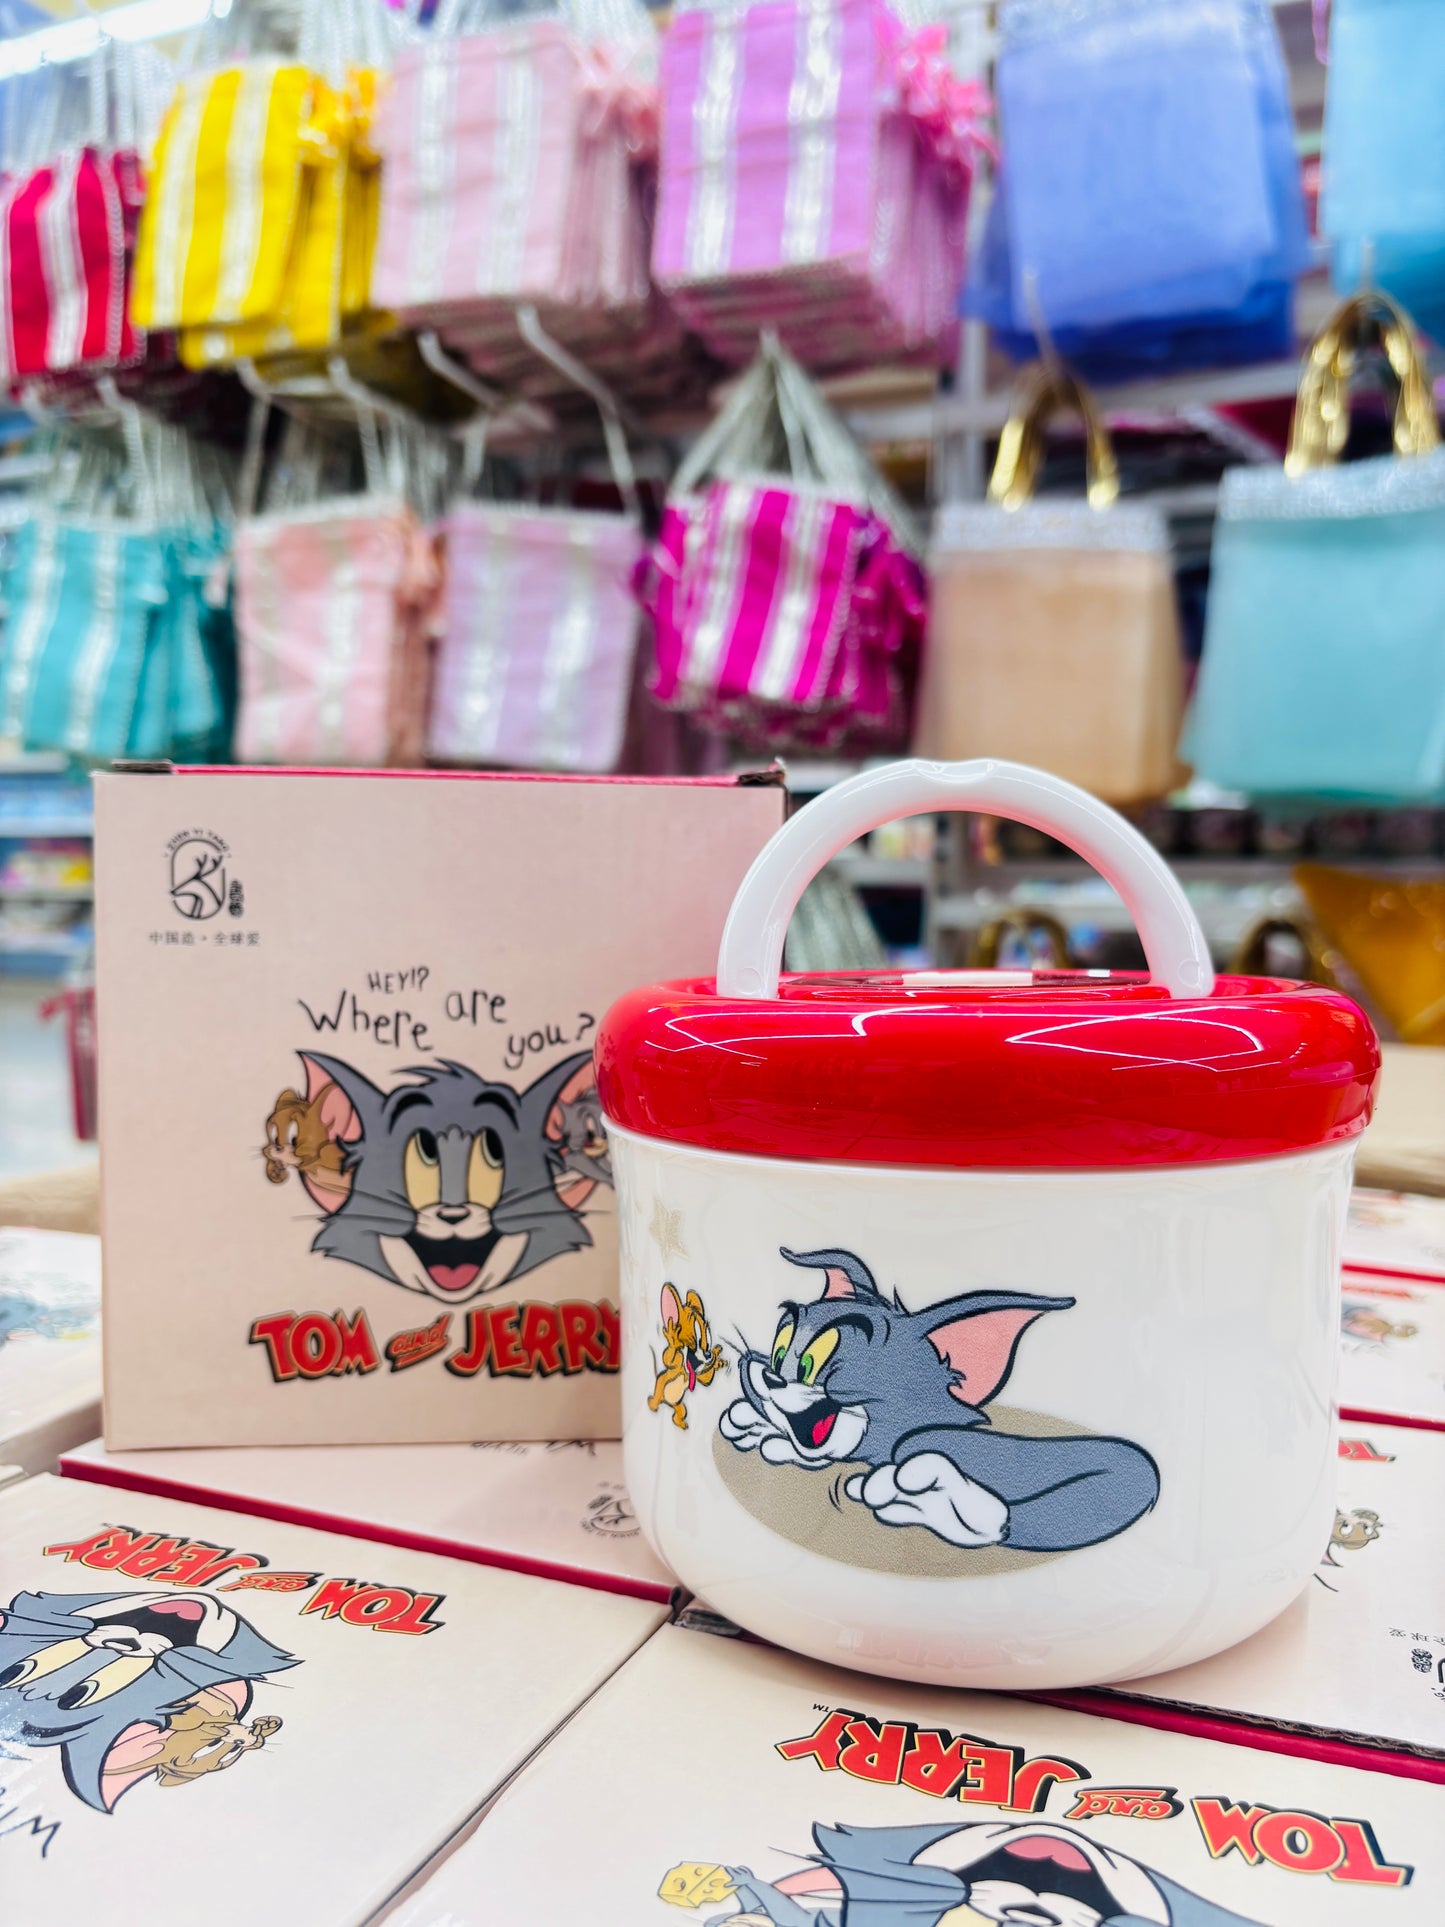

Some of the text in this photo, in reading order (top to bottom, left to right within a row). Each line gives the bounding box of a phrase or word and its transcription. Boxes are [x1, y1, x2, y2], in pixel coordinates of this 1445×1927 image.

[367, 966, 430, 993] HEY!?
[298, 989, 596, 1070] Where are you?
[249, 1307, 382, 1382] TOM
[385, 1311, 453, 1372] and
[43, 1525, 448, 1636] TOM and JERRY
[774, 1708, 1092, 1813] JERRY
[1063, 1785, 1184, 1821] and
[1190, 1795, 1415, 1887] TOM
